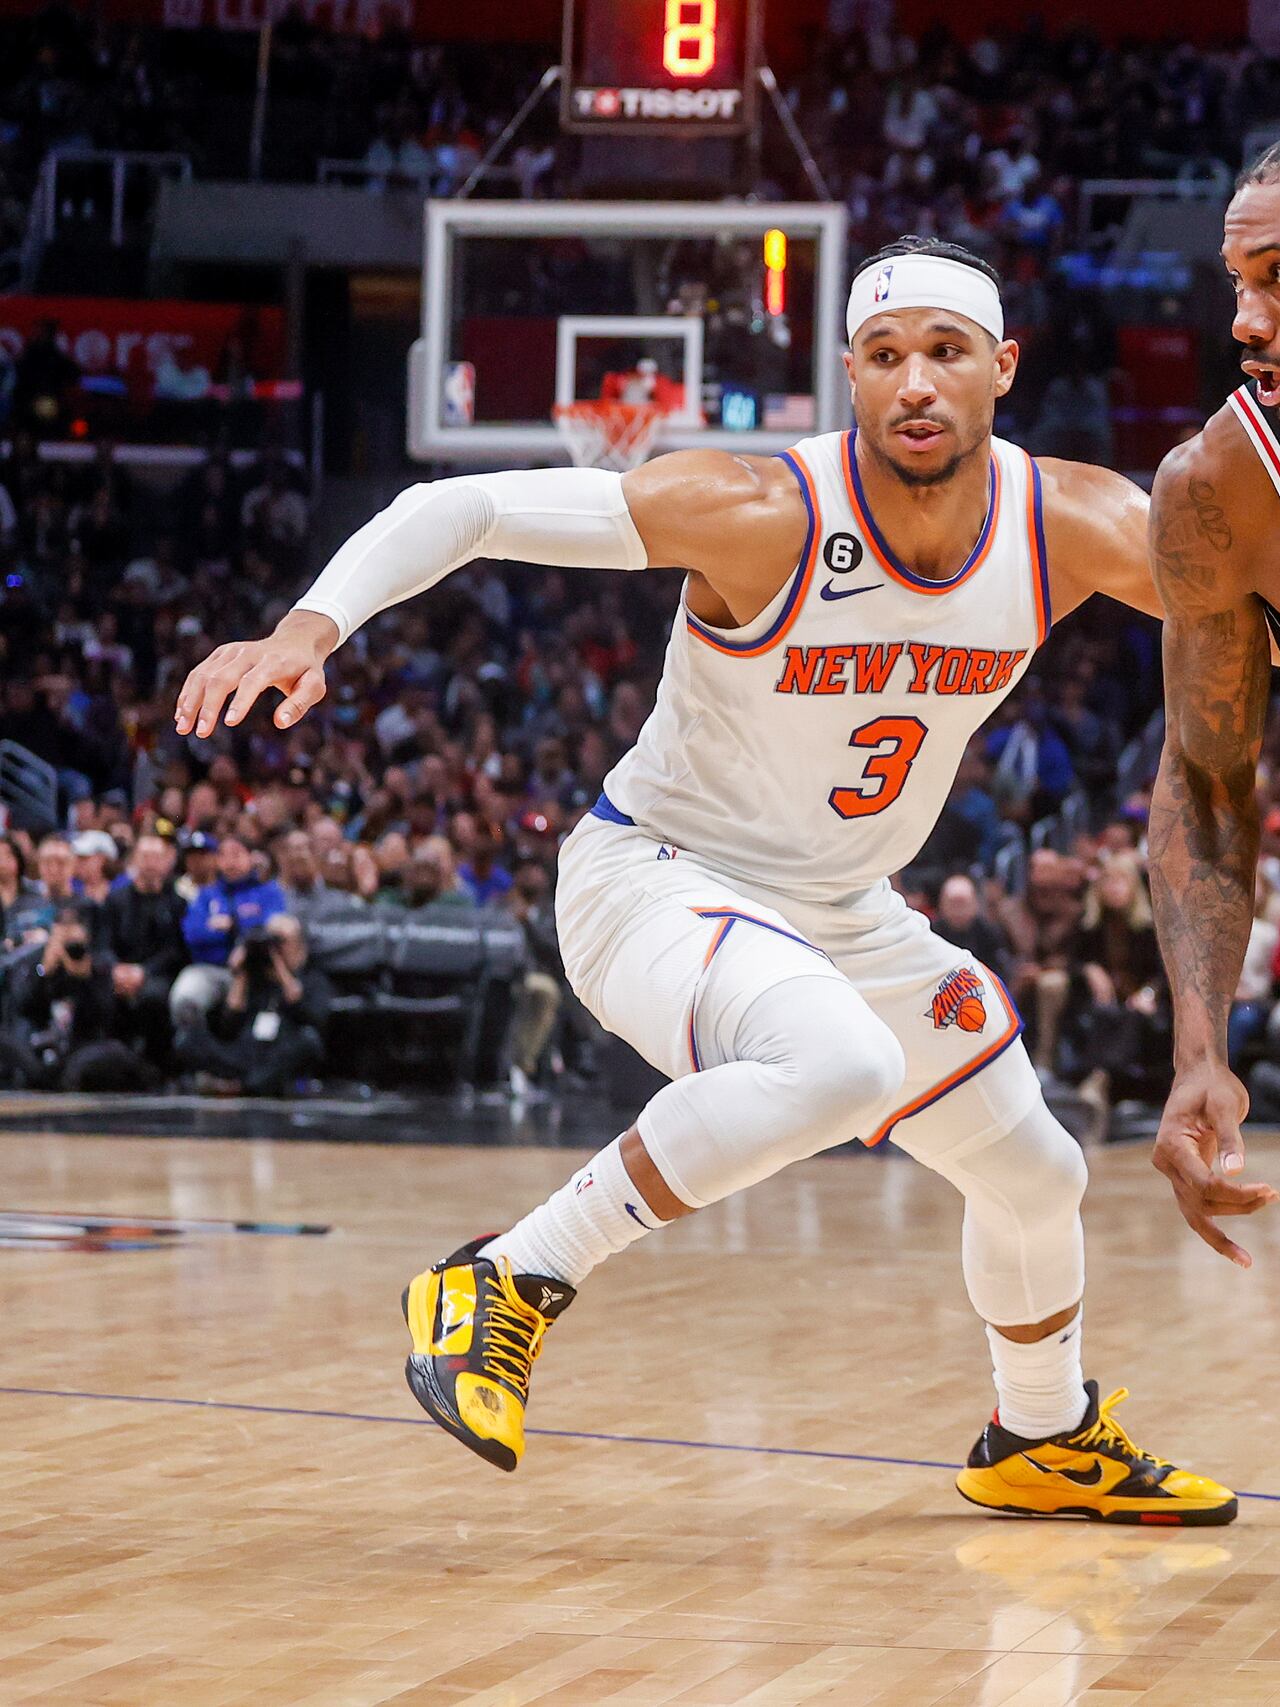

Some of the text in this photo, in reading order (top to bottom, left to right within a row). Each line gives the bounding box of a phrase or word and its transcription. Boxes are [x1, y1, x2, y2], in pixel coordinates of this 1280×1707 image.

[663, 0, 717, 77] 8
[830, 537, 855, 569] 6
[773, 640, 1029, 695] NEW YORK
[828, 715, 929, 820] 3
[931, 967, 984, 1030] KNICKS
